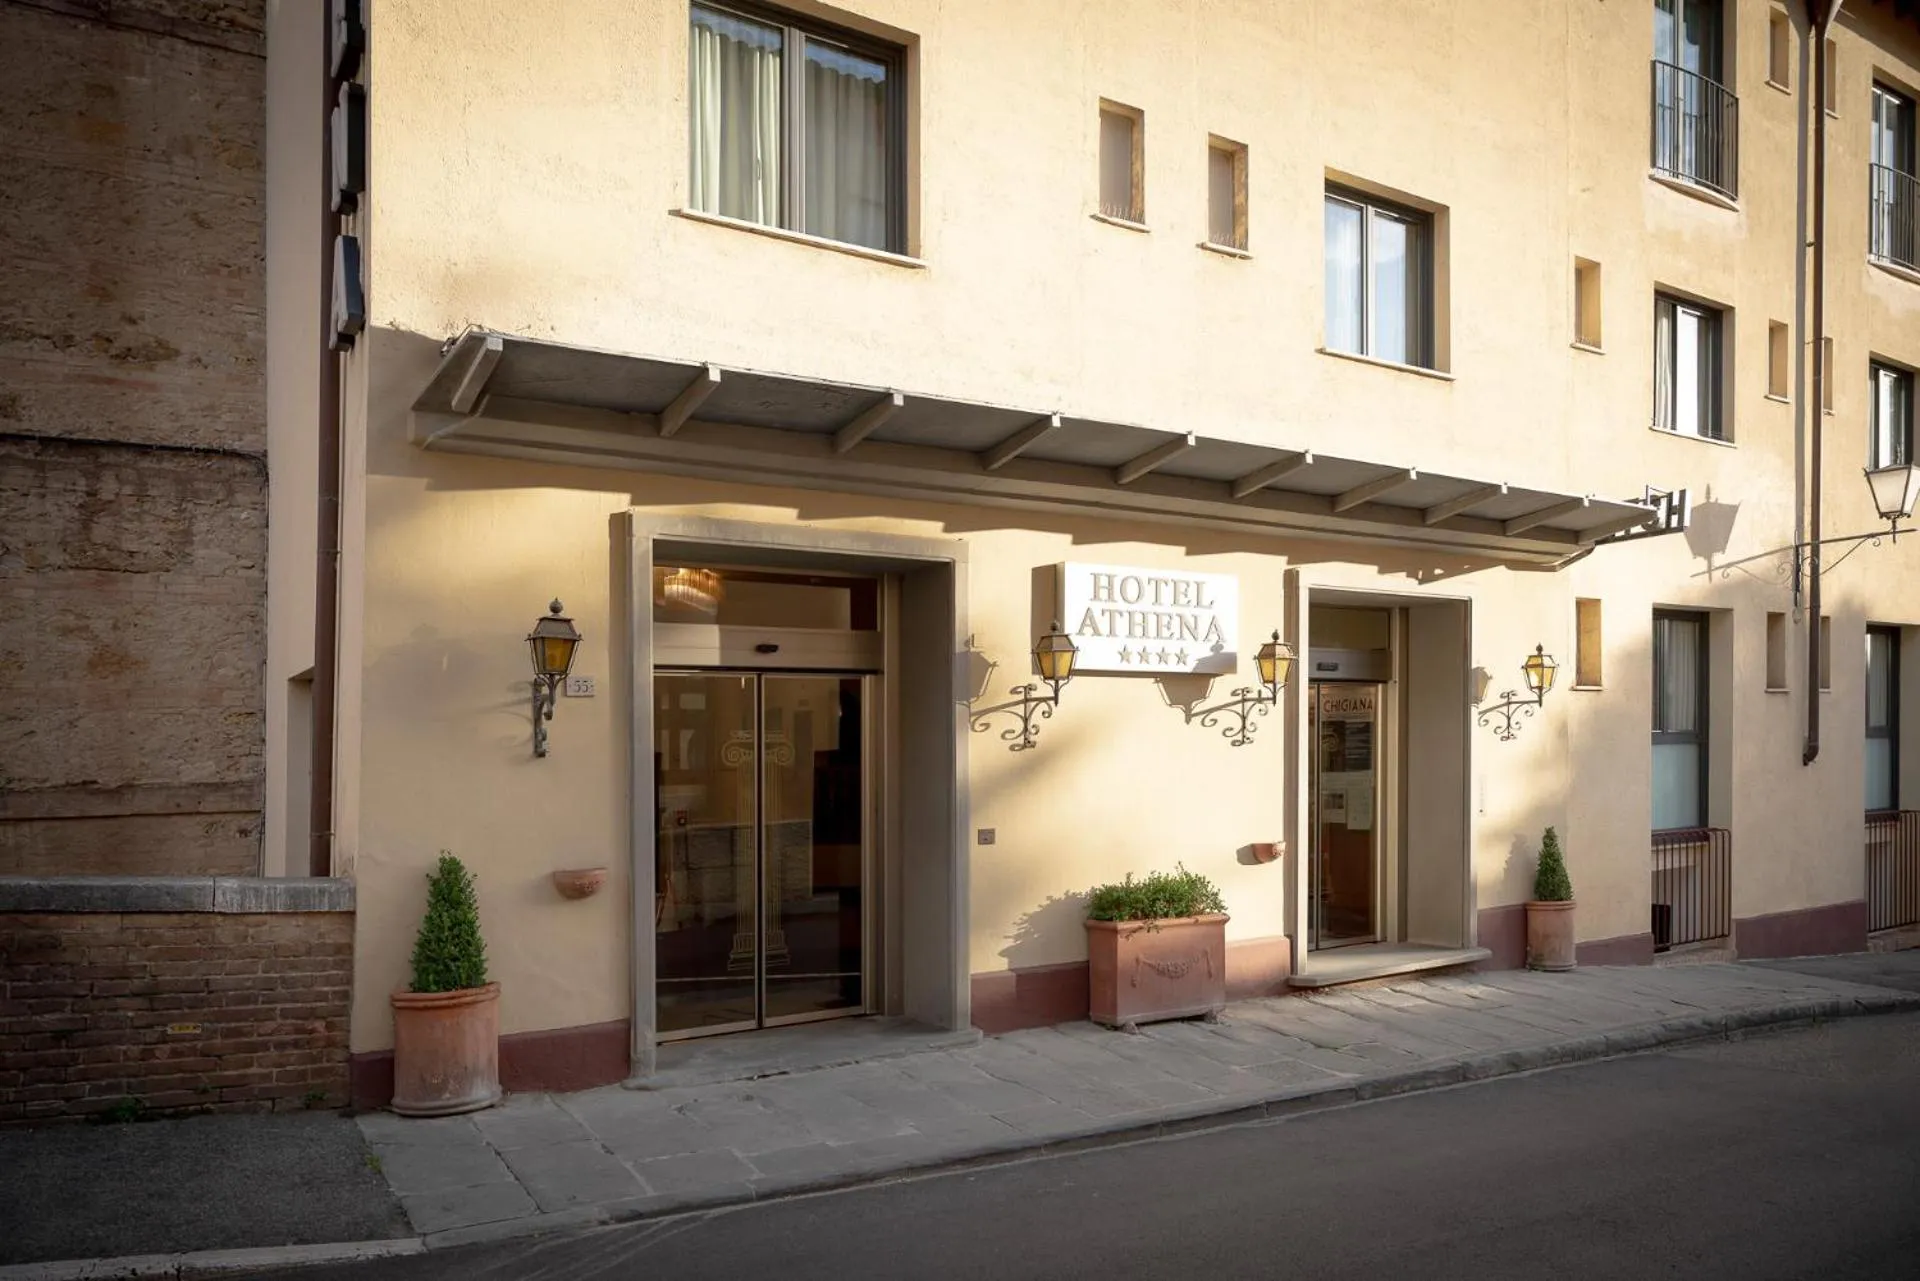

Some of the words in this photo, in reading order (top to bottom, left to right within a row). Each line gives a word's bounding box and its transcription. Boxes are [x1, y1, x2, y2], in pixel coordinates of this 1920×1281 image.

[1090, 571, 1215, 610] HOTEL
[1076, 606, 1226, 643] ATHENA
[574, 679, 589, 693] 55
[1323, 698, 1373, 713] CHIGIANA
